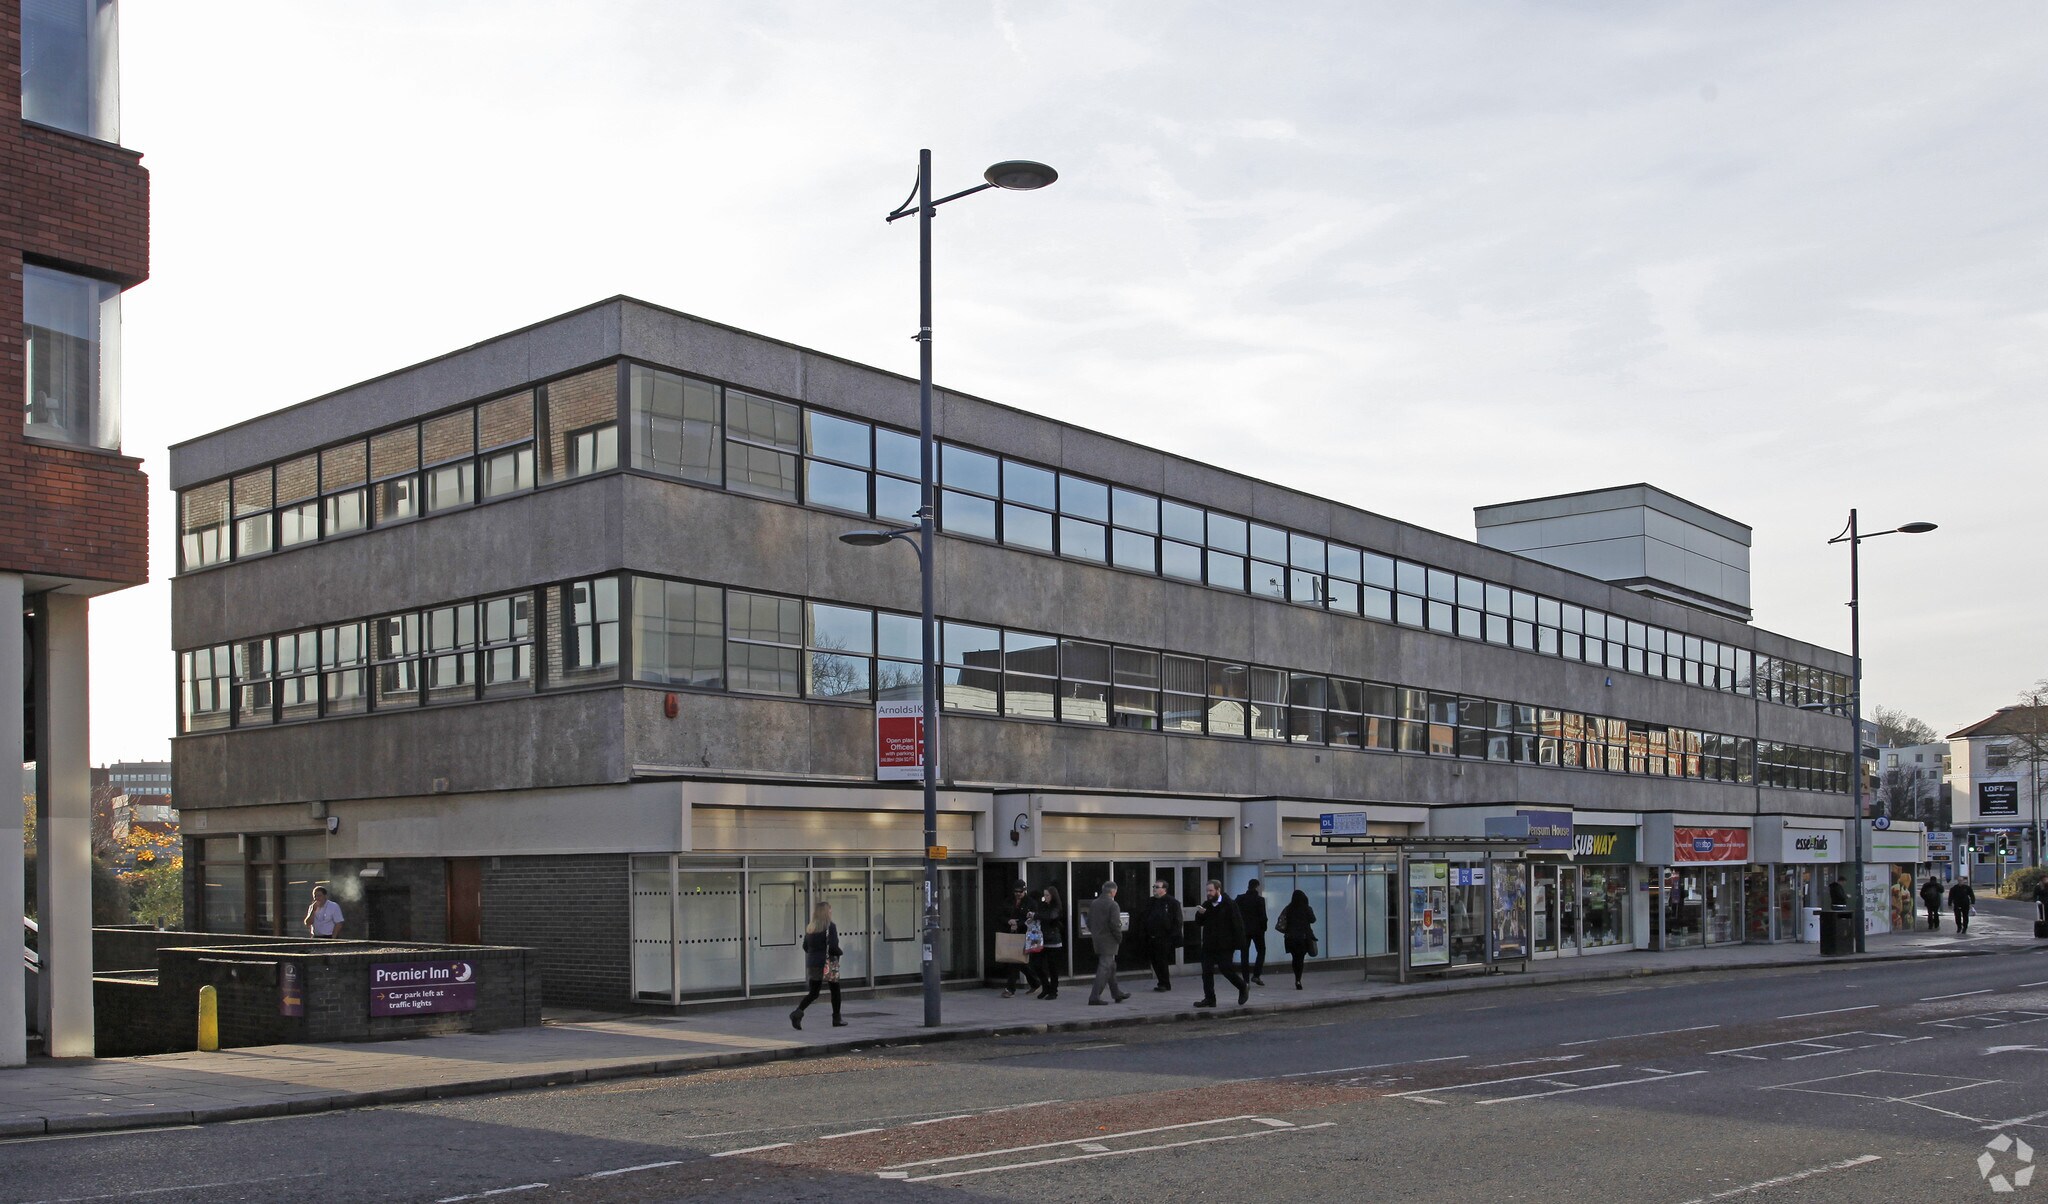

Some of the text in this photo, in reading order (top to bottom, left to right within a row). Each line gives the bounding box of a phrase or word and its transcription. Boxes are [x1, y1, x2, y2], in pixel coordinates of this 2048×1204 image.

[890, 743, 914, 751] Offices
[1322, 819, 1332, 827] DL
[1551, 824, 1569, 837] House
[1573, 833, 1618, 856] SUBWAY
[376, 966, 449, 982] Premier Inn
[404, 991, 421, 1000] park
[389, 999, 432, 1009] traffic lights
